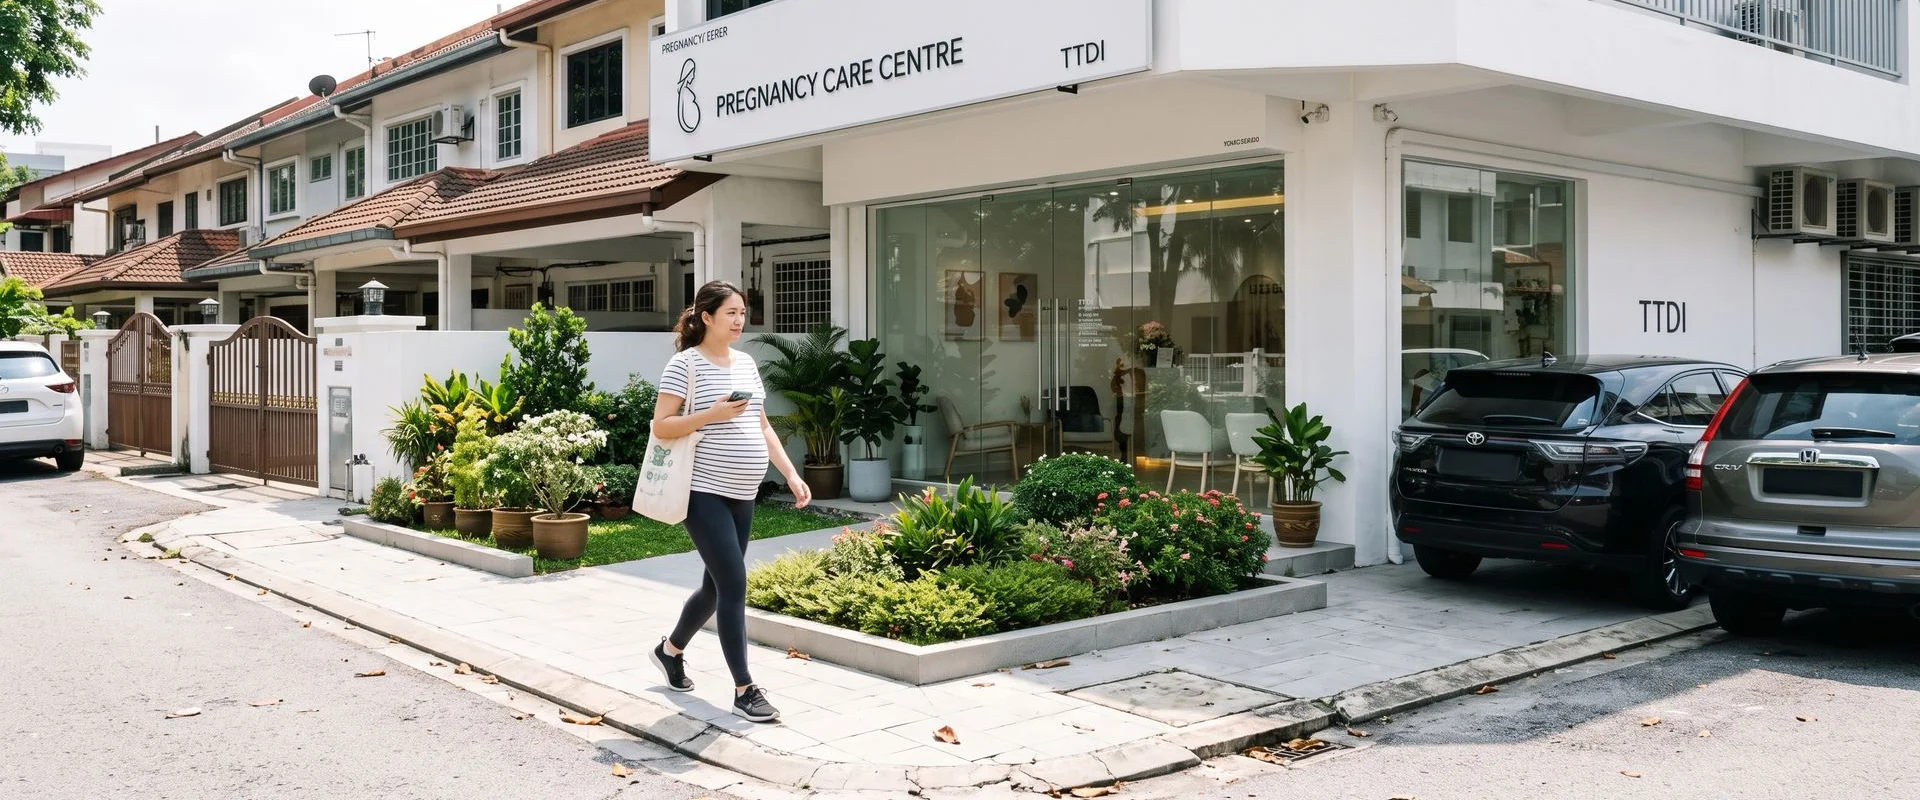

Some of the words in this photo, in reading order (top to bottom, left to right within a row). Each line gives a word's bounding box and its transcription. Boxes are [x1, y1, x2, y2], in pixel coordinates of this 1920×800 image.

[1060, 39, 1105, 69] TTDI
[716, 71, 819, 119] PREGNANCY
[823, 58, 874, 95] CARE
[878, 36, 964, 82] CENTRE
[1638, 299, 1687, 333] TTDI
